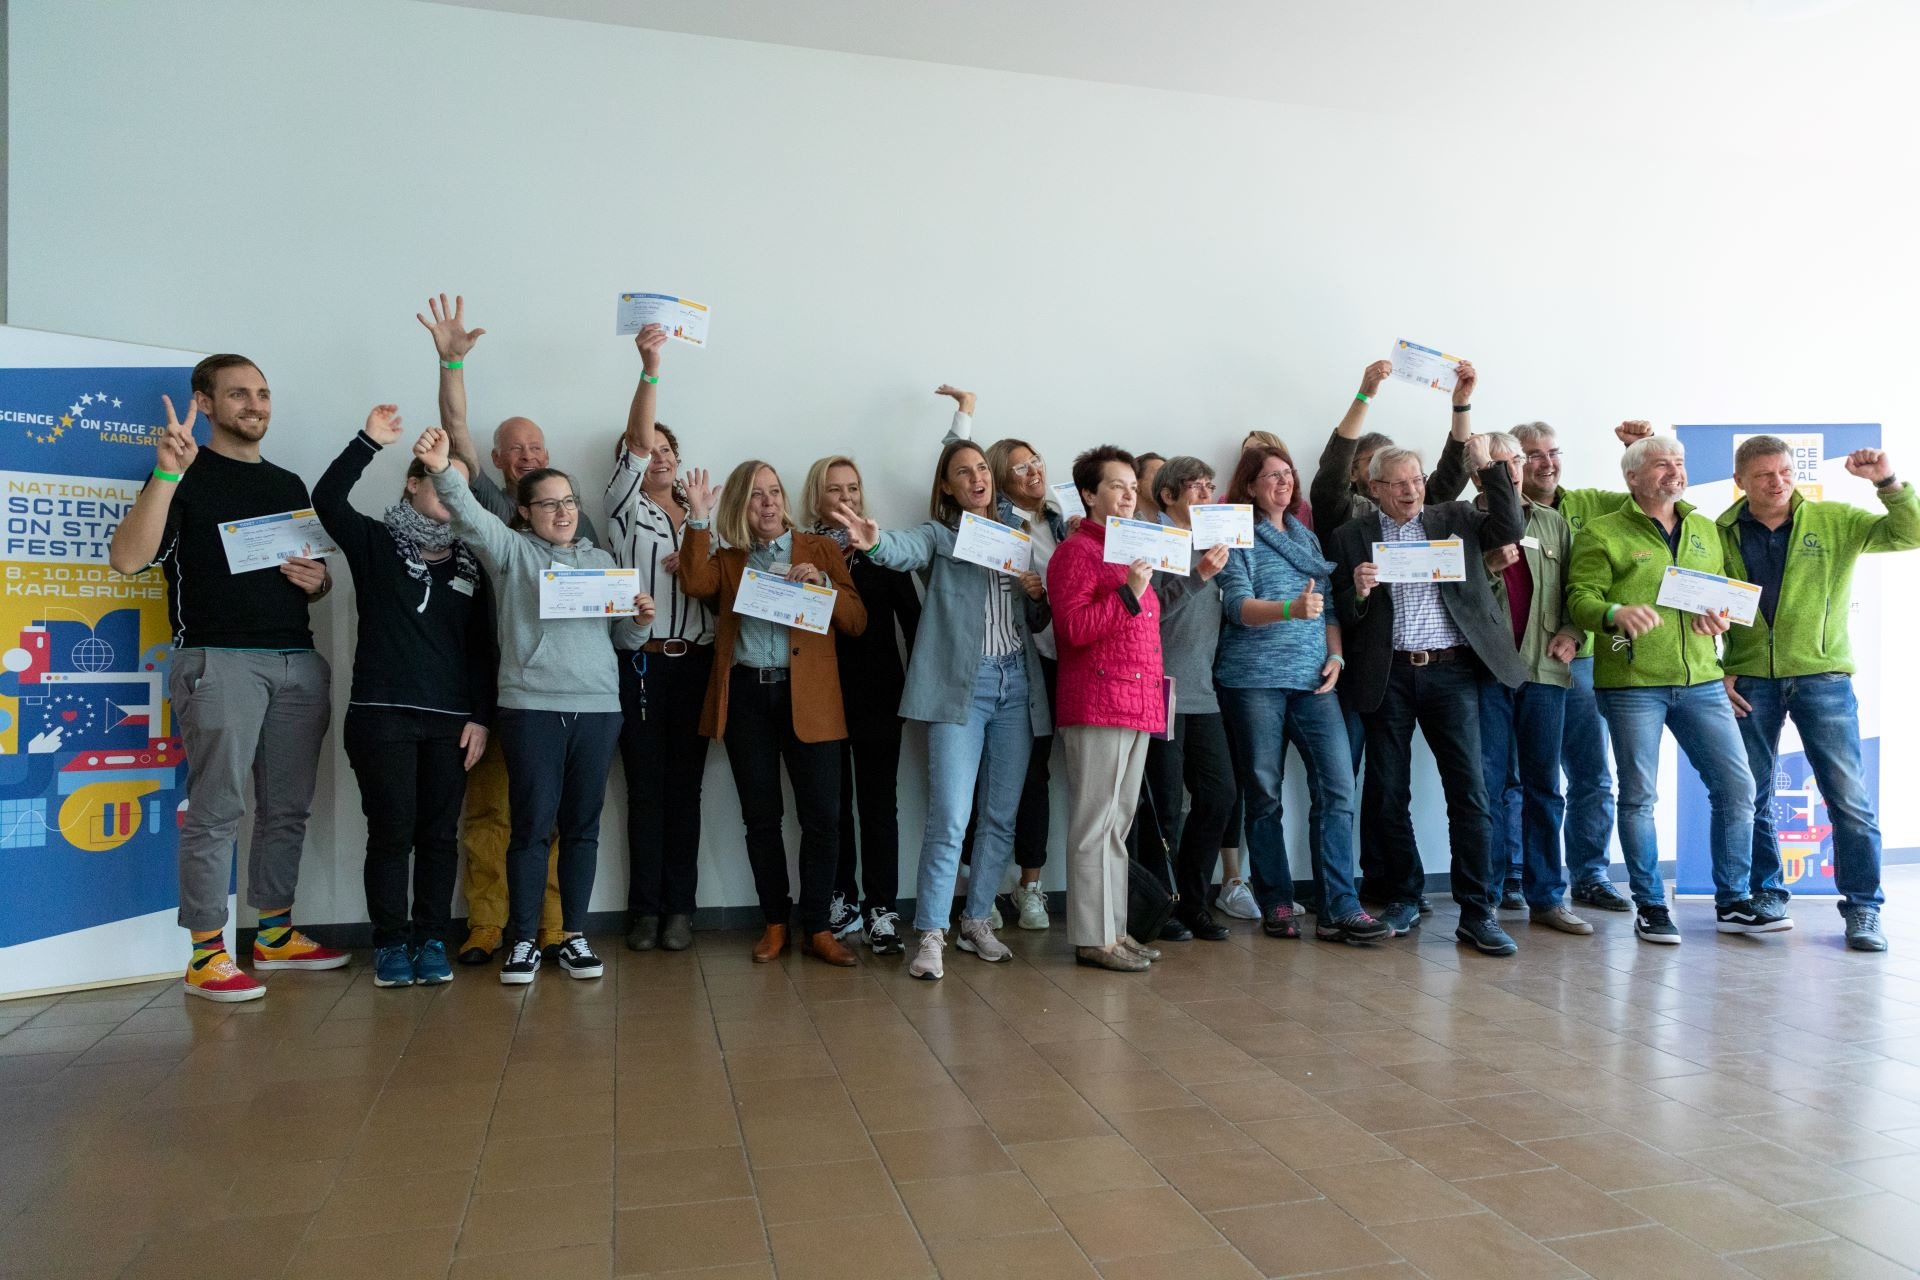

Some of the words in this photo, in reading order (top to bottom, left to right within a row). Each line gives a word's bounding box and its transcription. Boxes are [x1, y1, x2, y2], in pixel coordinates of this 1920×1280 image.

[80, 418, 101, 430] ON
[104, 421, 146, 435] STAGE
[149, 425, 165, 437] 20
[100, 431, 161, 447] KARLSRU
[8, 496, 134, 519] SCIEN
[8, 518, 51, 535] ON
[63, 521, 119, 539] STA
[7, 538, 112, 558] FESTI
[6, 583, 163, 599] KARLSRUHE
